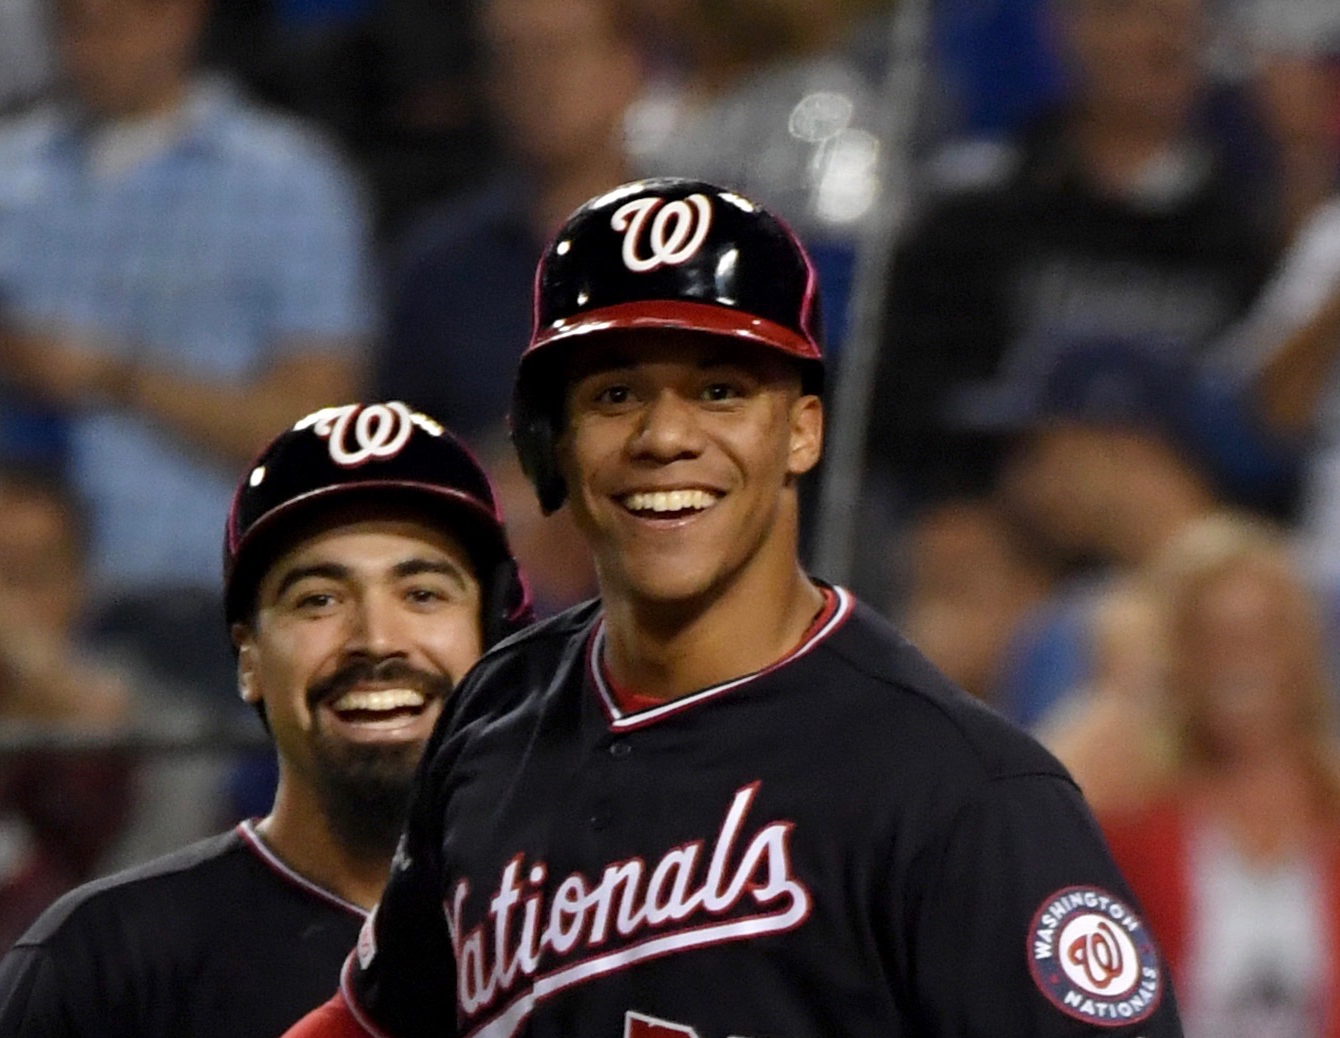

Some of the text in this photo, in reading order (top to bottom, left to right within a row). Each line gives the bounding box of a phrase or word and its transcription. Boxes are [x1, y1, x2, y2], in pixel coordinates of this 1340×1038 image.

[610, 193, 712, 273] W
[314, 401, 414, 470] W
[1034, 891, 1141, 960] WASHINGTON
[1063, 966, 1158, 1019] NATIONALS
